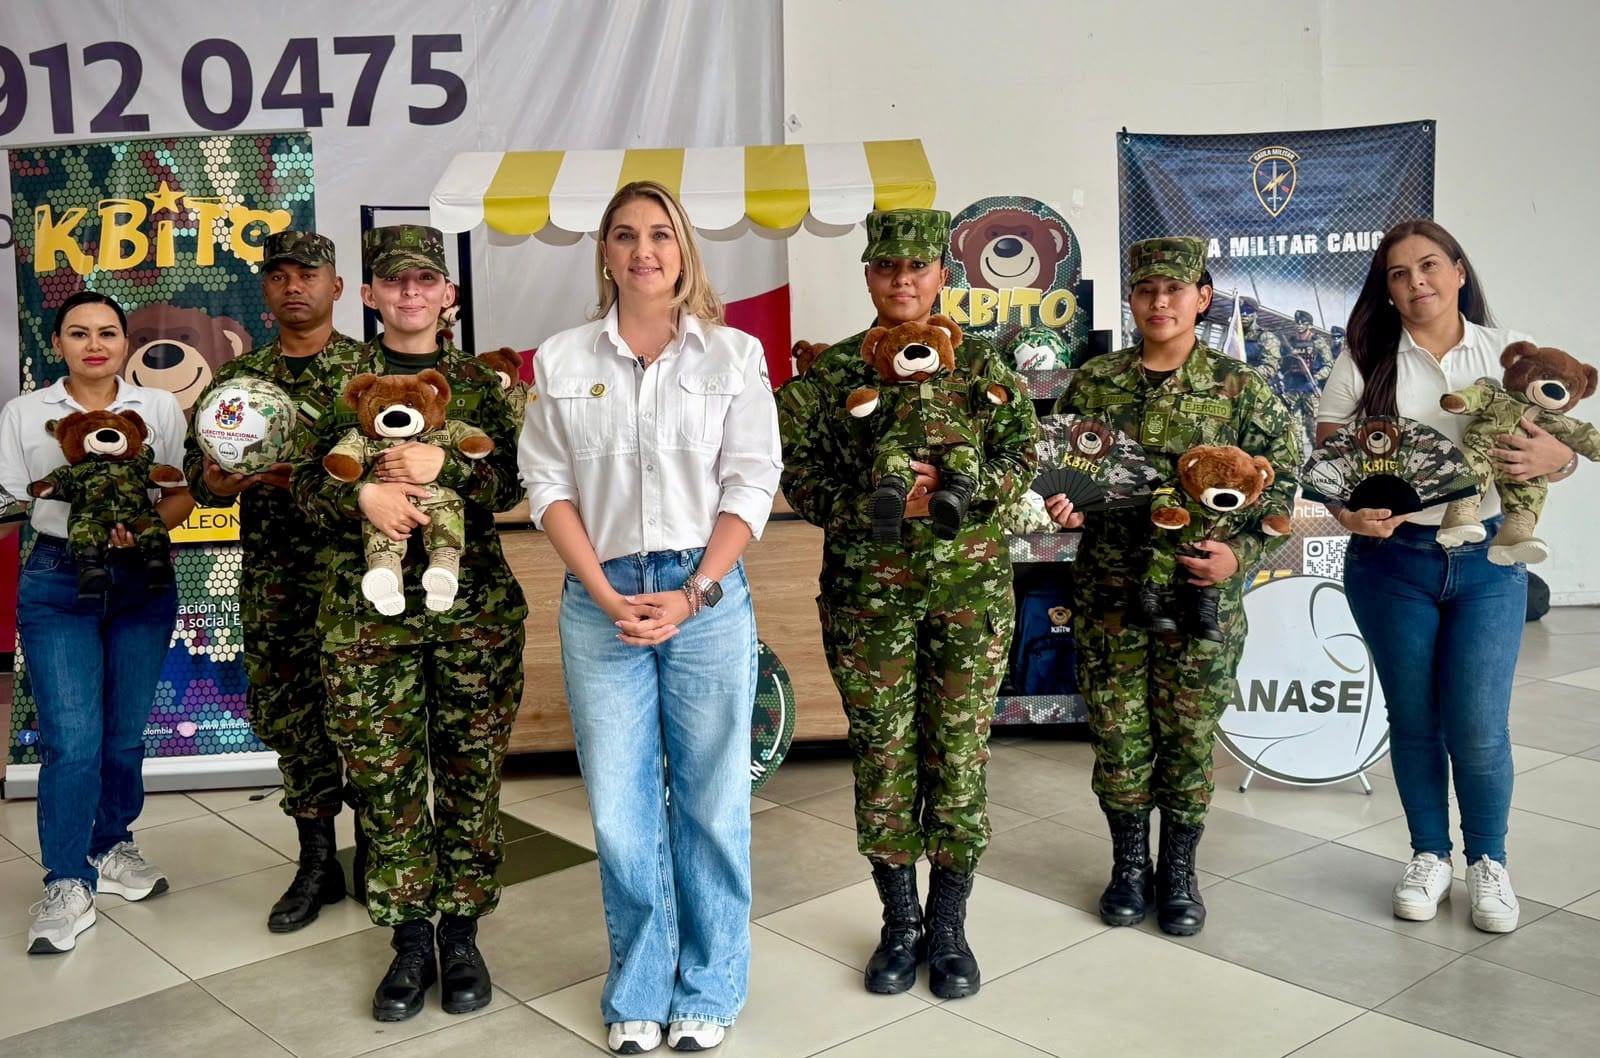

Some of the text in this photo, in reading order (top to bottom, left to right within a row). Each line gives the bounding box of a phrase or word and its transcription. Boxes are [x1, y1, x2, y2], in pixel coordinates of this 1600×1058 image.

[181, 34, 468, 131] 0475
[1230, 234, 1318, 257] MILITAR
[941, 287, 1077, 328] KBITO
[178, 600, 240, 614] ación Na
[189, 613, 228, 628] social
[1222, 679, 1365, 713] ANASE
